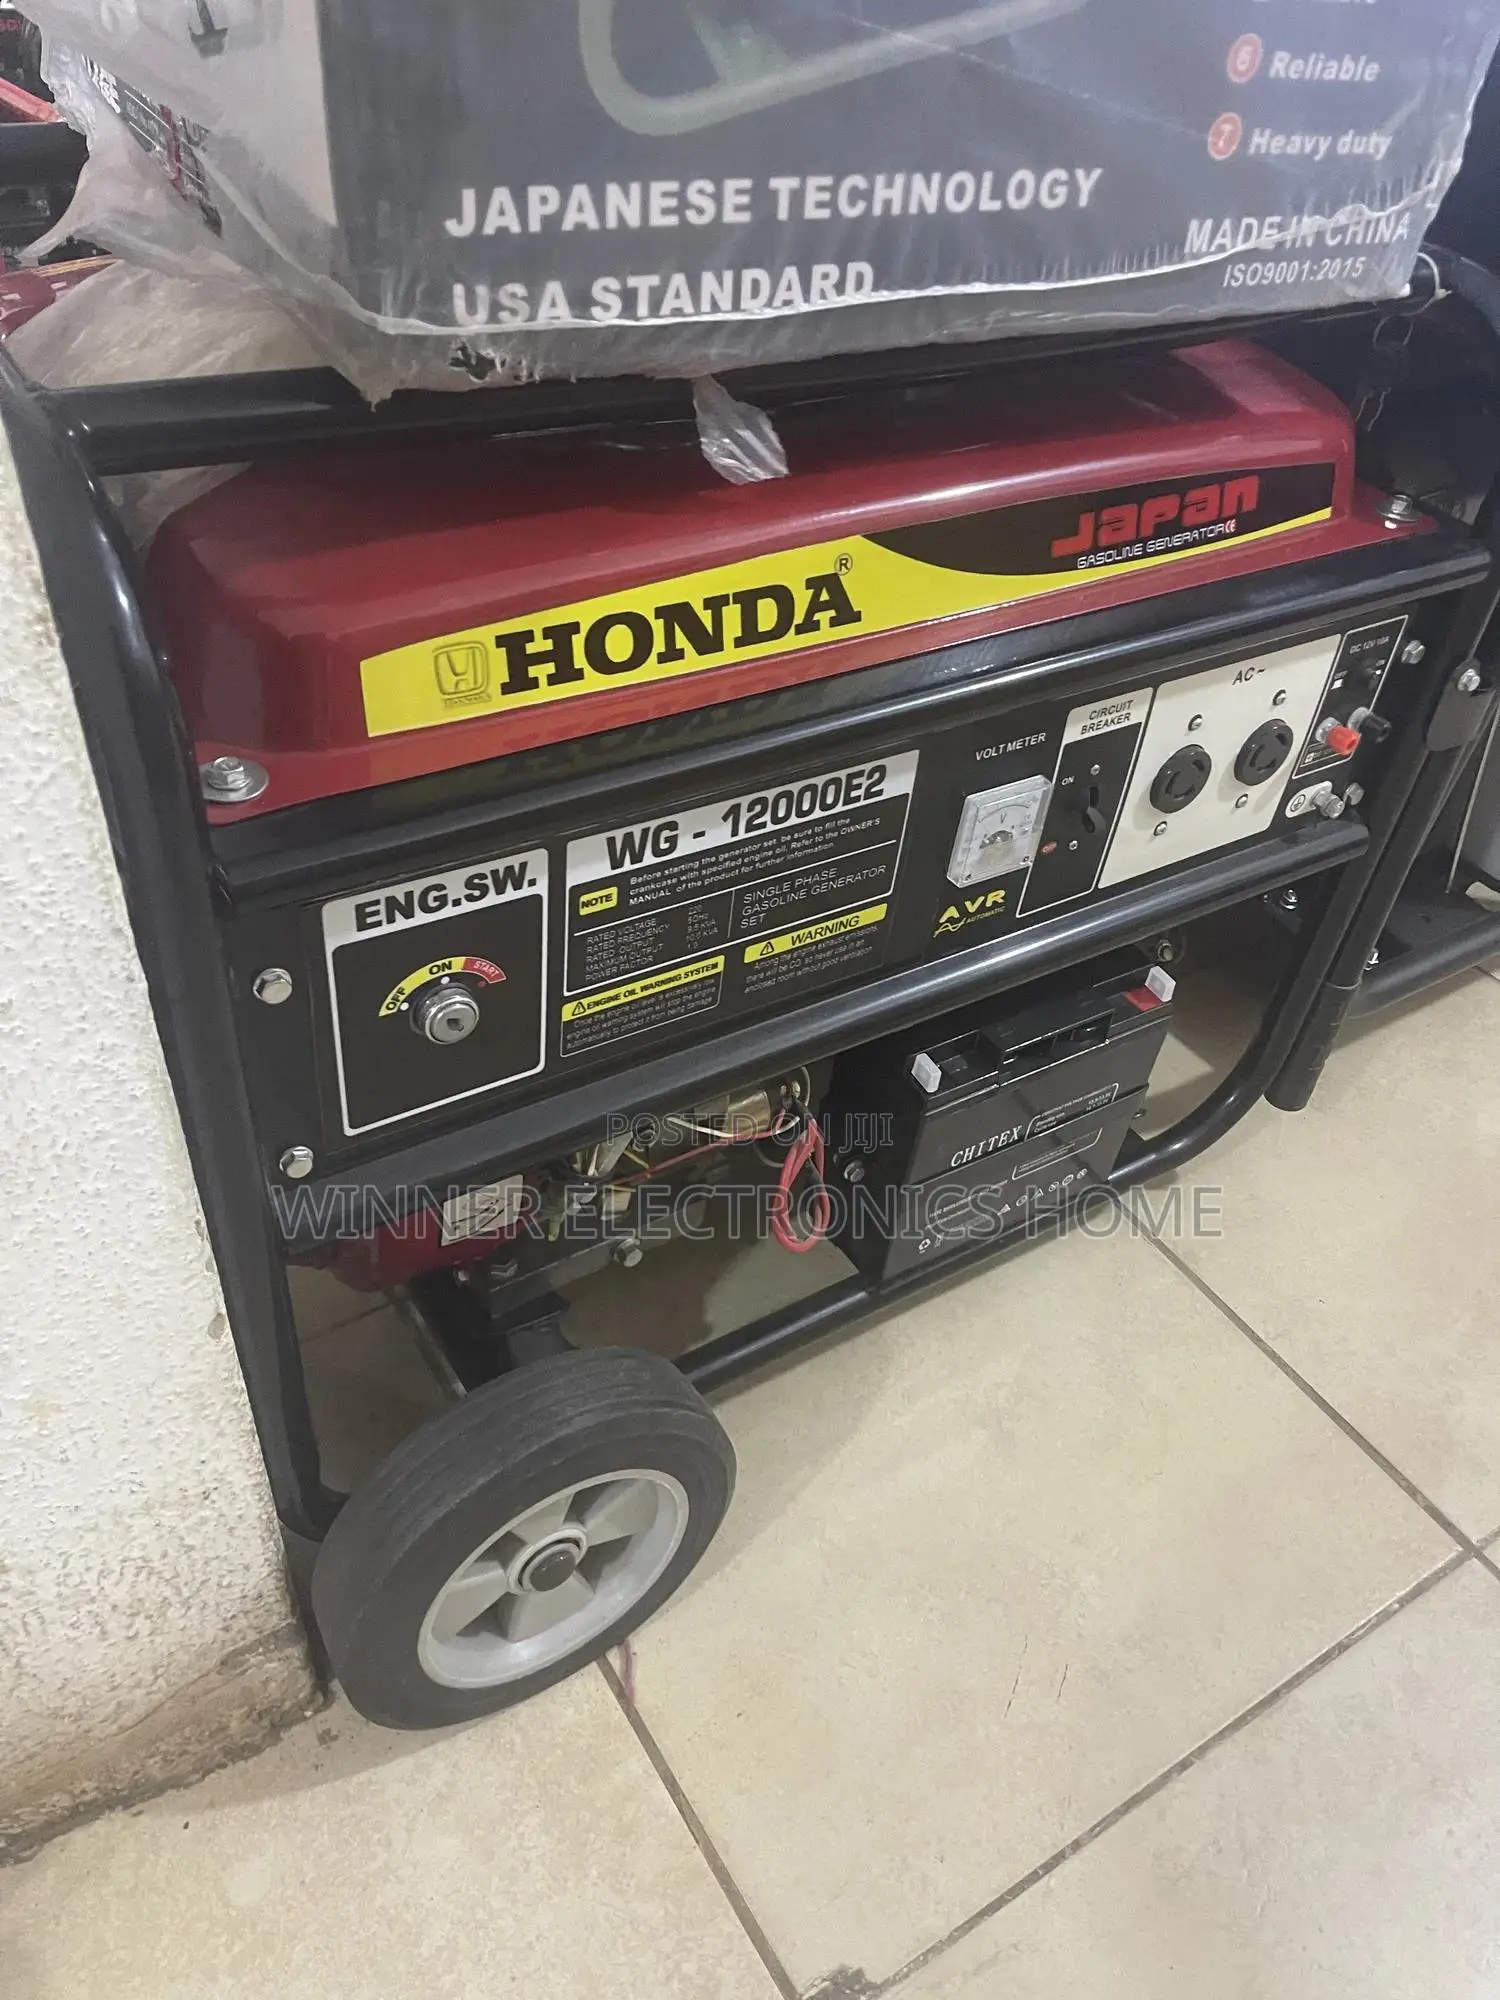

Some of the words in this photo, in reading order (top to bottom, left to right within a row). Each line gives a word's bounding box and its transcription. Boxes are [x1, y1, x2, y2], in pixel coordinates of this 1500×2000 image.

[1270, 50, 1381, 82] Reliable
[1218, 123, 1233, 148] 7
[1248, 127, 1331, 162] Heavy
[1337, 129, 1392, 161] duty
[444, 178, 753, 238] JAPANESE
[769, 168, 1103, 221] TECHNOLOGY
[1184, 215, 1283, 253] MADE
[1285, 214, 1317, 250] IN
[1324, 210, 1411, 246] CHINA
[1223, 257, 1366, 287] ISO9001:2015
[453, 280, 573, 326] USA
[590, 261, 874, 321] STANDARD
[1077, 543, 1143, 569] GASOLINE
[1146, 523, 1225, 553] GENERATOR
[495, 572, 862, 696] HONDA
[1080, 712, 1132, 736] BREAKER
[1089, 700, 1134, 721] CIRCUIT
[975, 744, 1005, 761] VOLT
[1006, 732, 1047, 752] METER
[1061, 775, 1075, 786] ON
[606, 820, 679, 871] WG
[720, 763, 887, 838] 12000E2
[629, 877, 678, 895] crankcase
[680, 870, 699, 881] with
[701, 858, 742, 876] specified
[744, 849, 773, 864] engine
[791, 837, 813, 849] Refer
[825, 830, 838, 840] the
[840, 817, 880, 835] OWNER'S
[630, 870, 662, 885] Before
[664, 860, 700, 876] starting
[701, 855, 717, 865] the
[718, 842, 761, 861] generator
[763, 838, 777, 848] set
[781, 835, 792, 843] be
[793, 829, 812, 839] sure
[814, 825, 823, 833] to
[837, 818, 850, 826] the
[354, 861, 538, 932] ENG.SW.
[629, 888, 672, 906] MANUAL
[676, 882, 686, 893] of
[687, 880, 702, 889] the
[704, 869, 739, 886] product
[741, 863, 753, 873] for
[755, 855, 785, 870] further
[742, 889, 807, 917] GASOLINE
[811, 864, 887, 896] GENERATOR
[743, 881, 791, 904] SINGLE
[794, 867, 838, 888] PHASE
[580, 892, 614, 912] NOTE
[938, 889, 1006, 924] AVR
[587, 930, 616, 944] RATED
[740, 913, 766, 929] SET
[791, 915, 860, 947] WARNING
[586, 939, 616, 954] RATED
[586, 949, 615, 963] RATED
[428, 960, 453, 975] ON
[473, 960, 499, 978] START
[586, 992, 621, 1010] ENGINE
[623, 987, 638, 999] OIL
[640, 973, 682, 991] WARNING
[684, 962, 719, 979] SYSTEM
[386, 986, 407, 1011] OFF
[951, 1125, 1023, 1168] CHITEX
